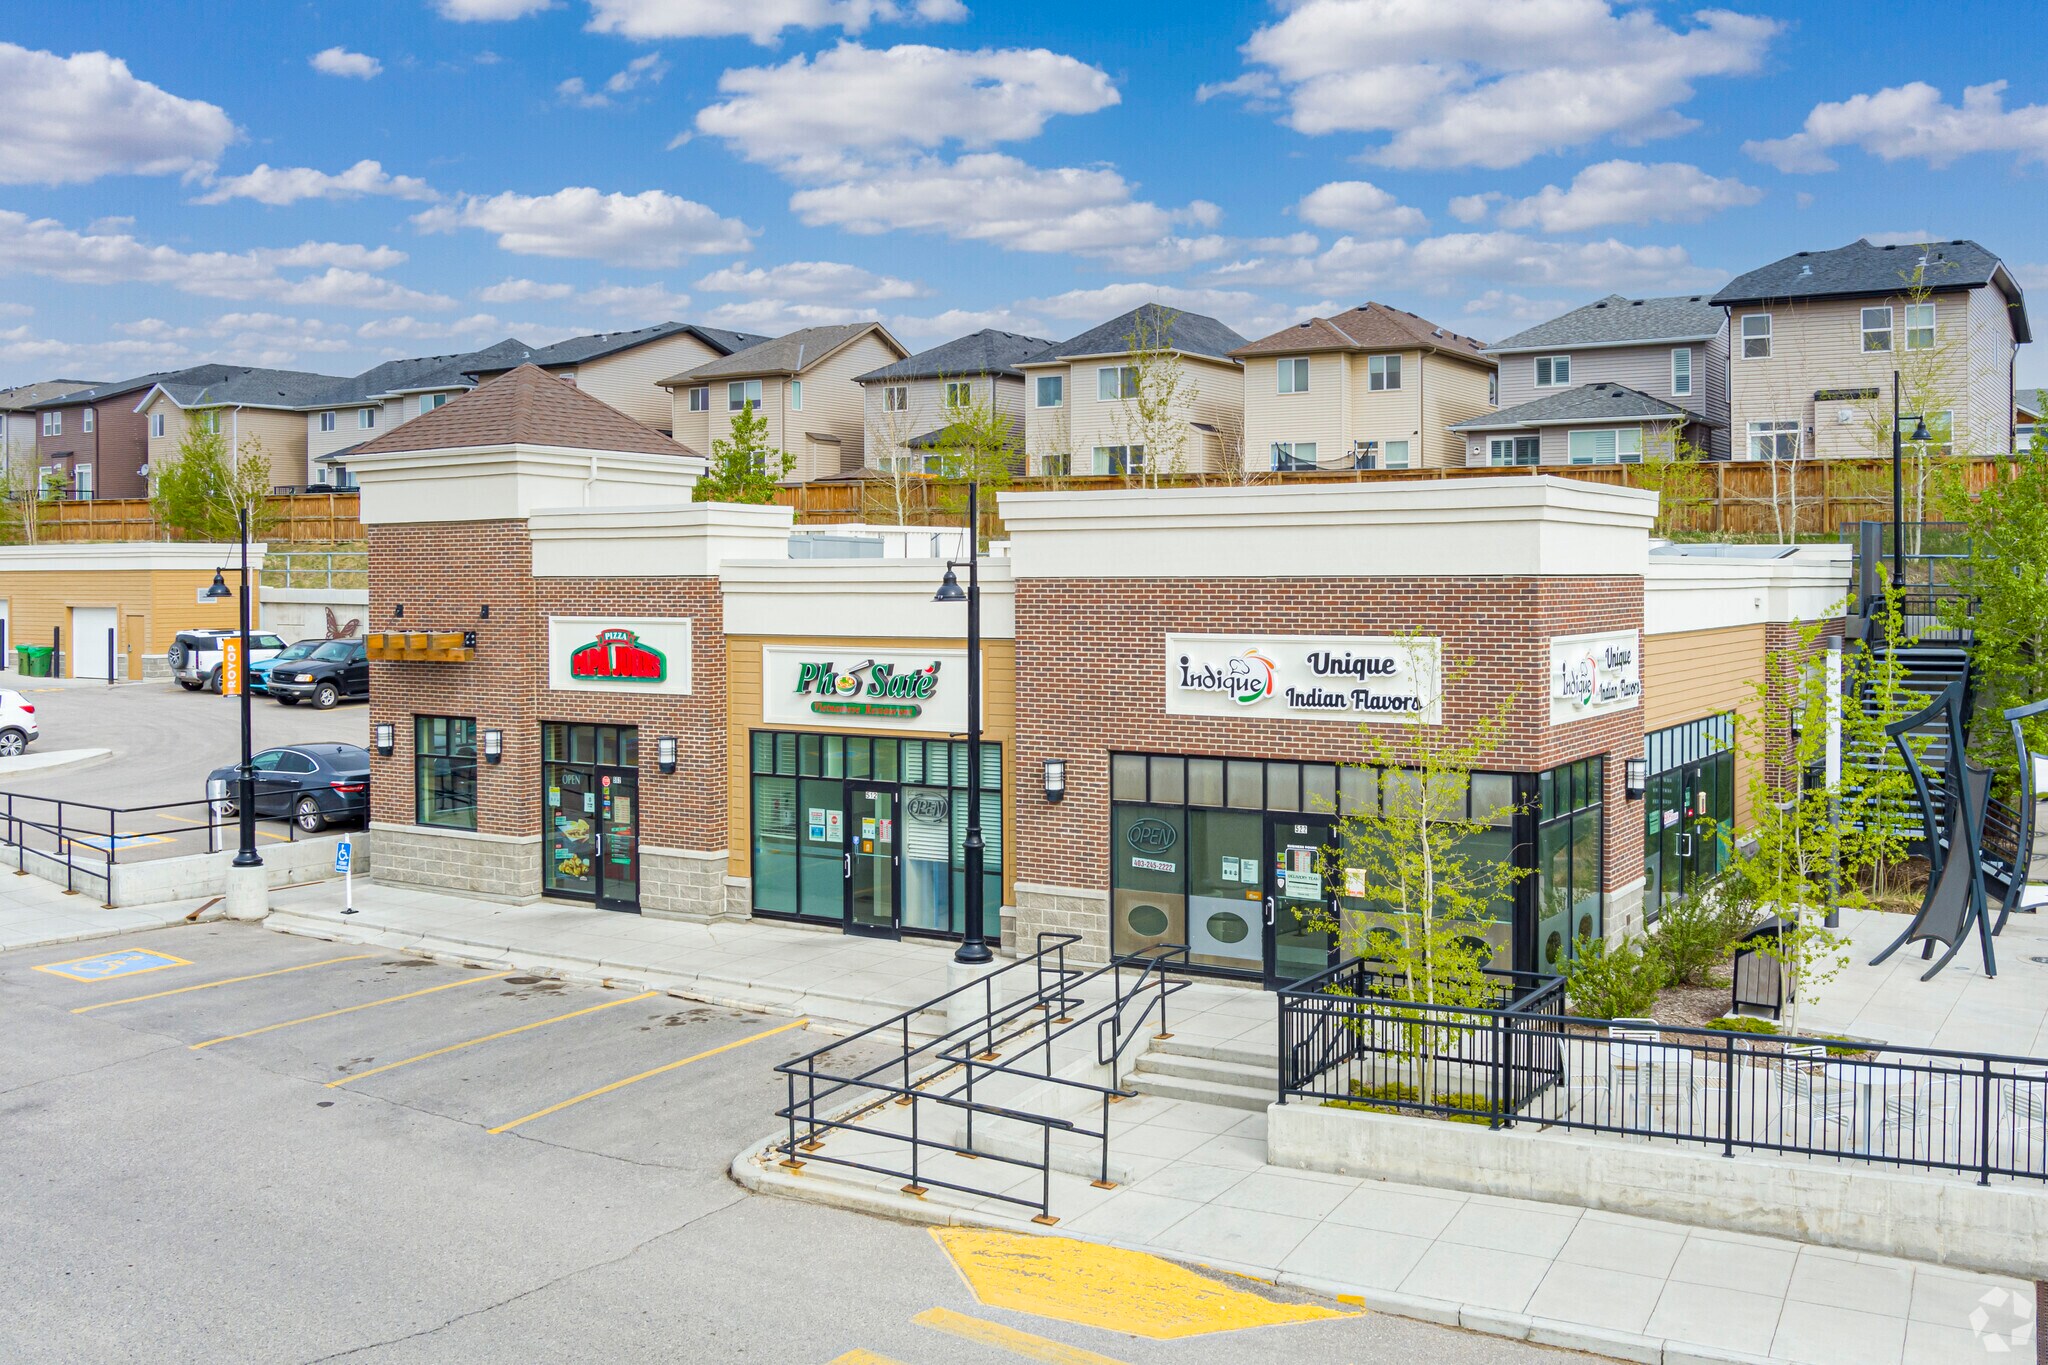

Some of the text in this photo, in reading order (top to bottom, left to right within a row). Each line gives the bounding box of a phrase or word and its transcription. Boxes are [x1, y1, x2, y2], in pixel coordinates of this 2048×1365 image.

[604, 632, 627, 641] PIZZA
[227, 645, 236, 688] ROYOP
[1307, 652, 1397, 681] Unique
[1605, 646, 1632, 672] Unique
[1180, 655, 1262, 698] Indique
[1562, 662, 1592, 702] Indique
[1285, 687, 1423, 711] Indian Flavors
[1600, 678, 1640, 702] Indian Flavors
[814, 702, 861, 714] Vietnamese
[562, 774, 581, 785] OPEN
[866, 791, 878, 799] 512
[910, 800, 947, 818] OPEN
[1130, 826, 1172, 846] OPEN
[1295, 825, 1307, 833] 522
